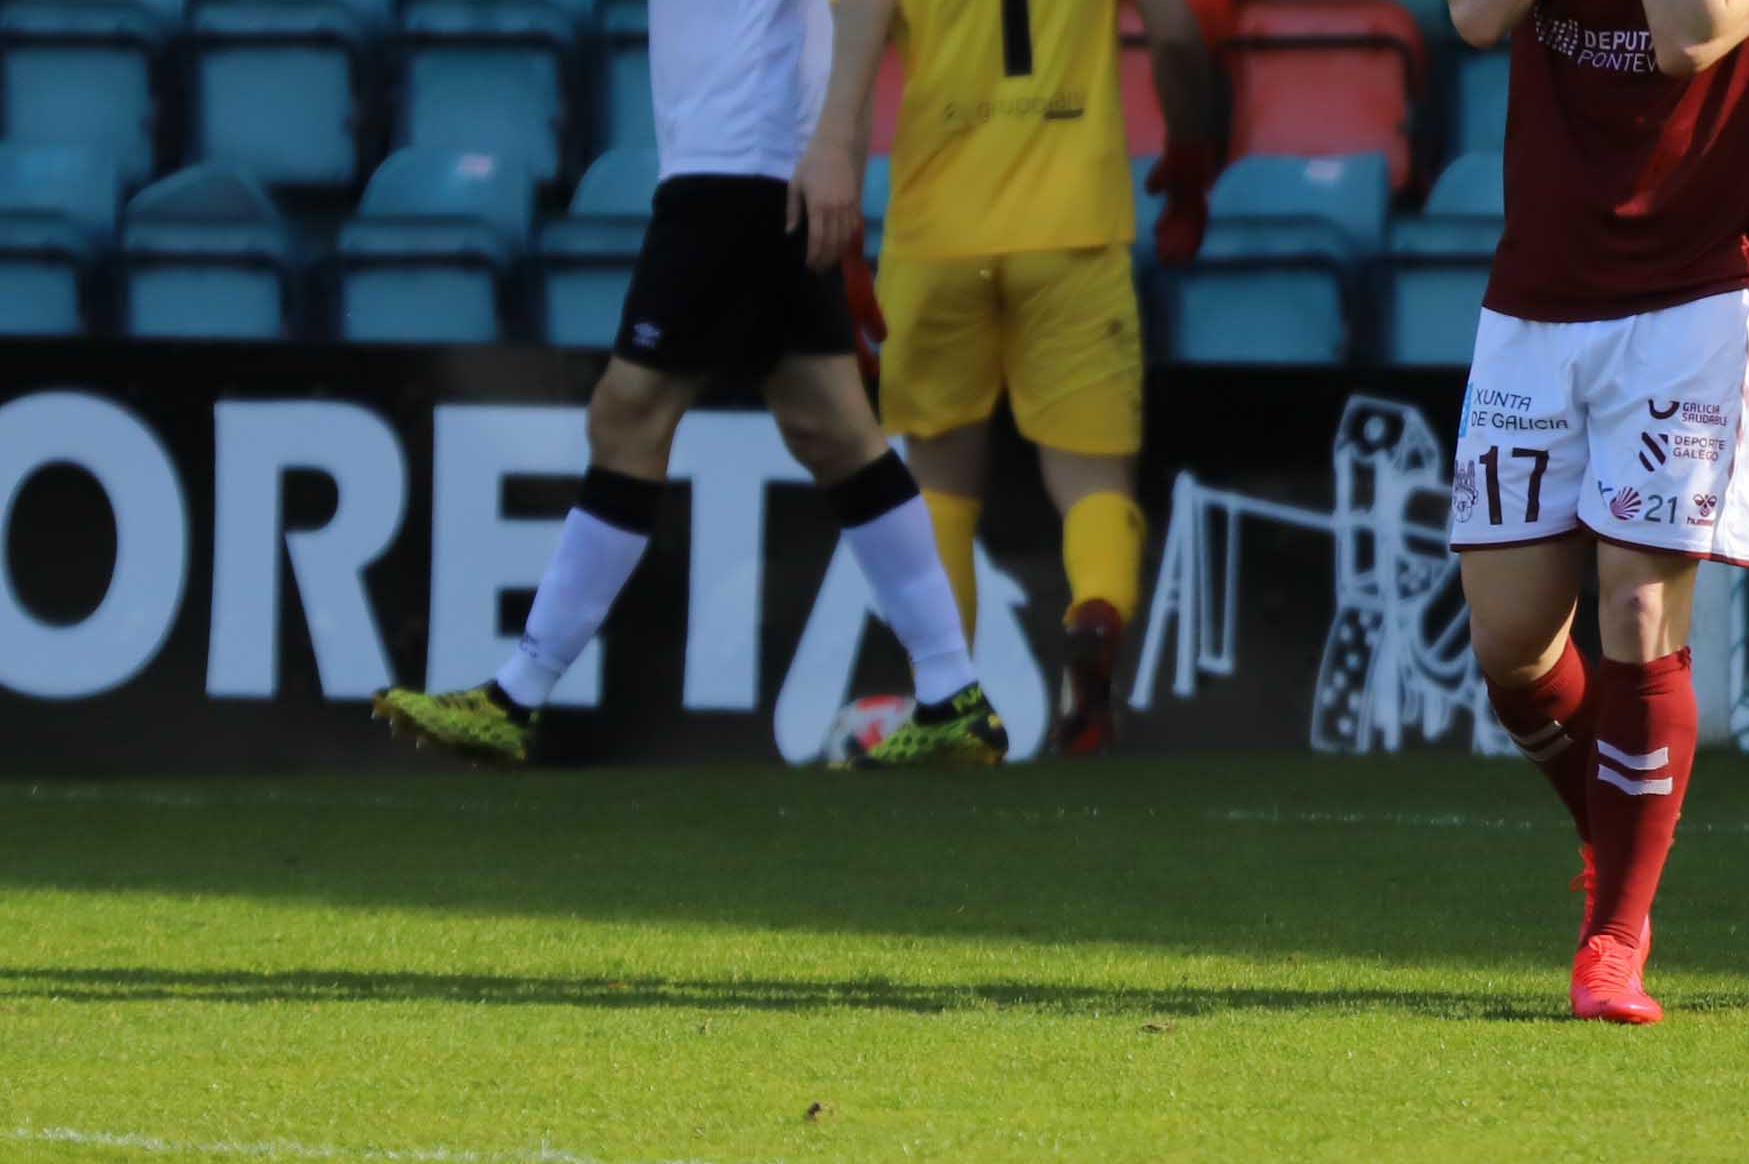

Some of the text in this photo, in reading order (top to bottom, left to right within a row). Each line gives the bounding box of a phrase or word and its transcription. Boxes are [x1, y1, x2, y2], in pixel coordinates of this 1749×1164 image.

[1473, 389, 1532, 411] XUNTA
[1682, 402, 1721, 414] GALICIA
[1471, 411, 1569, 431] DE GALICIA
[1674, 435, 1726, 450] DEPORTE
[1479, 445, 1550, 525] 17
[1643, 494, 1678, 524] 21
